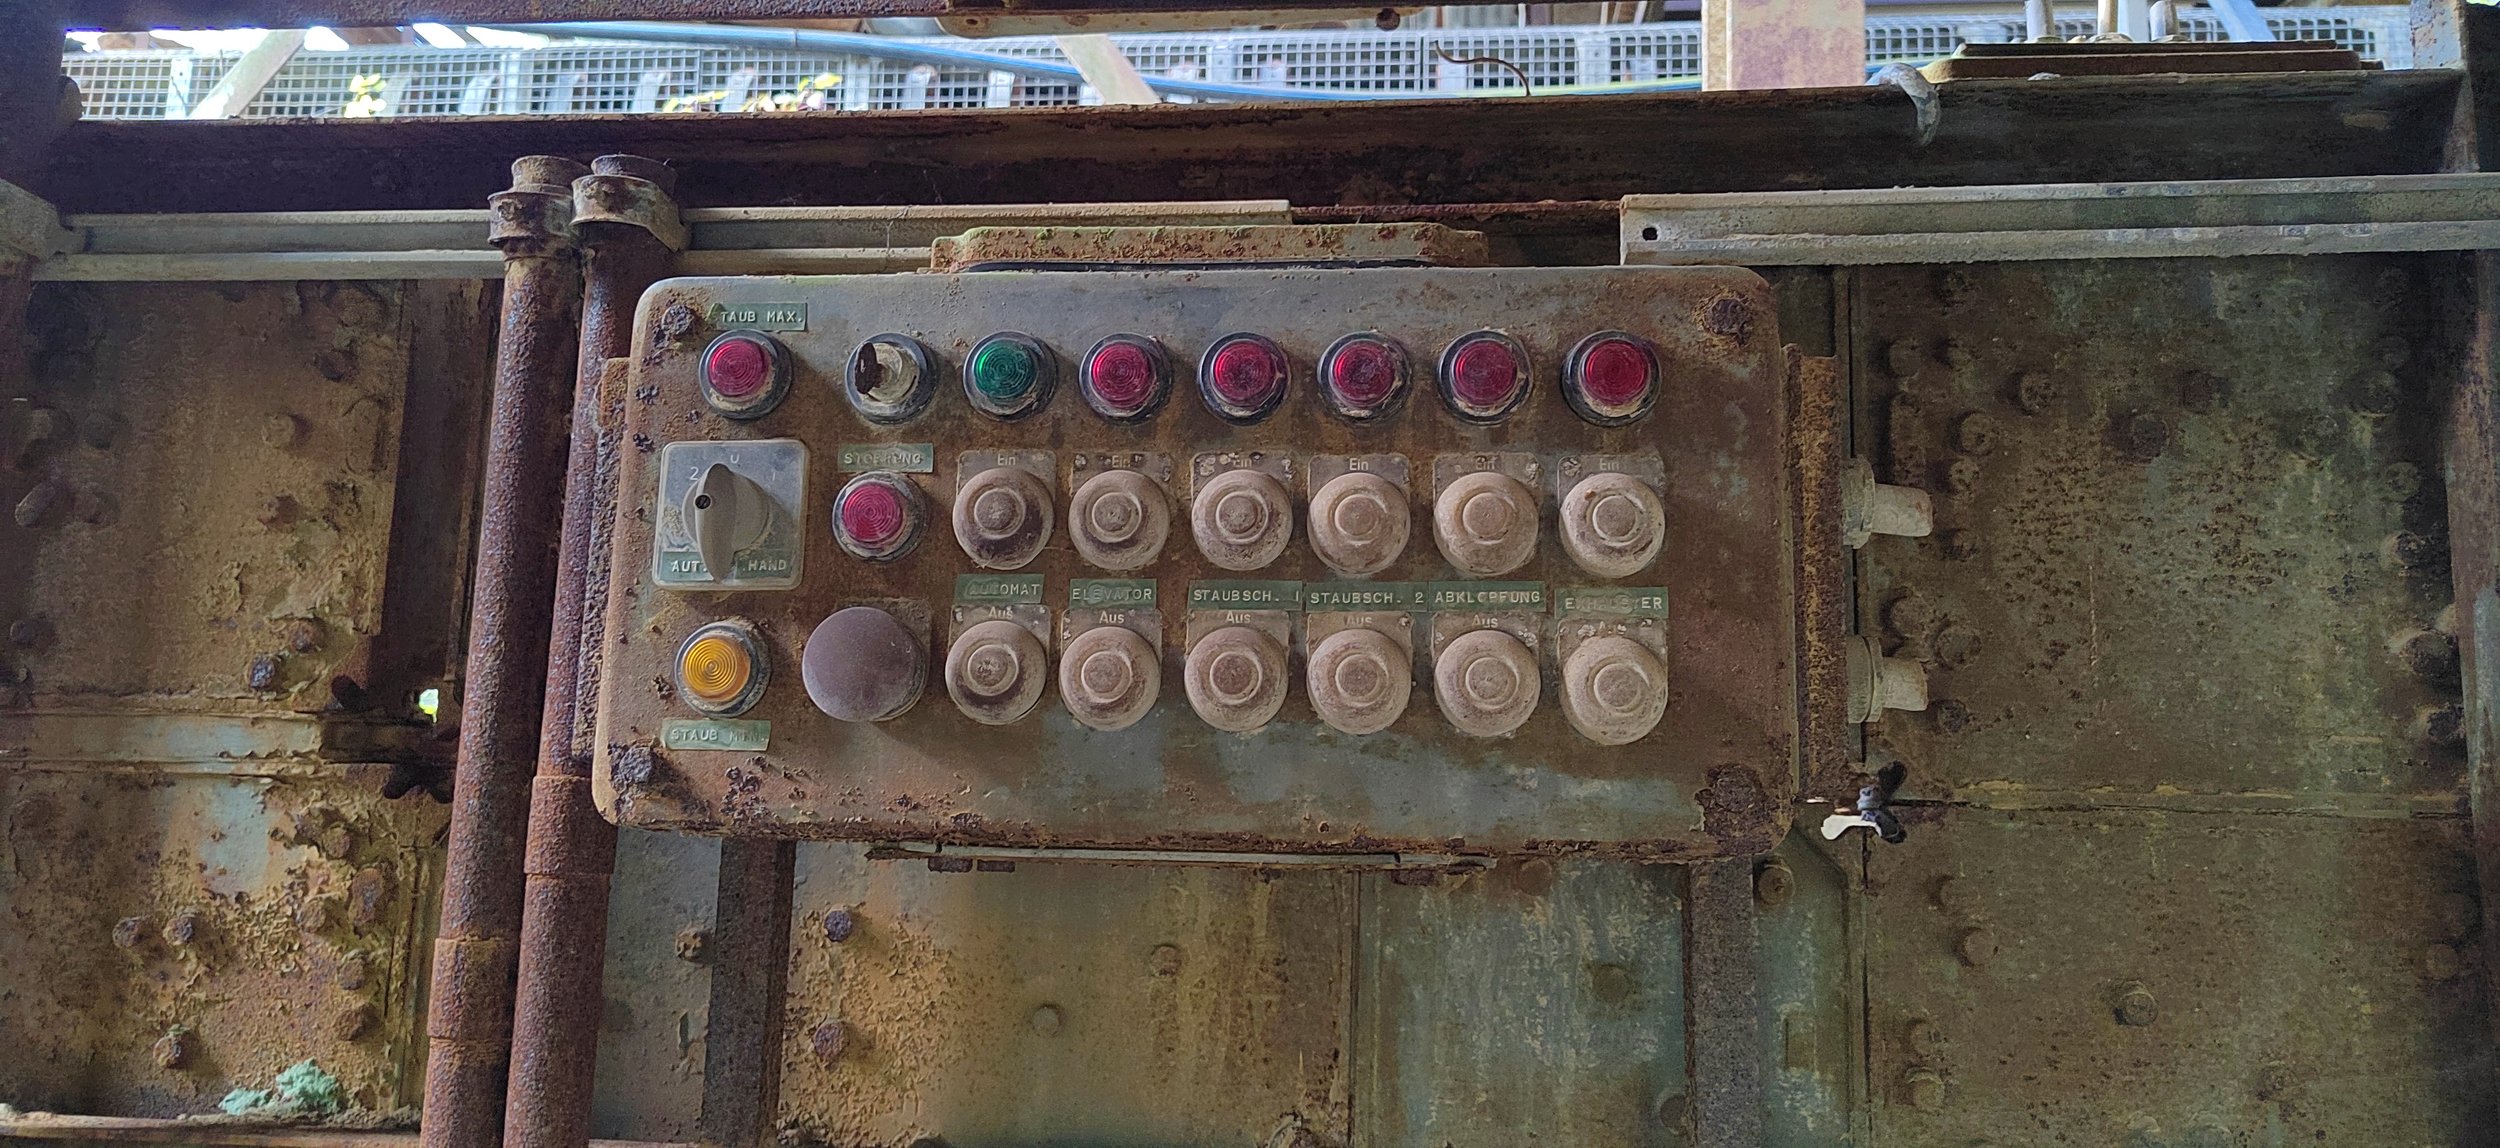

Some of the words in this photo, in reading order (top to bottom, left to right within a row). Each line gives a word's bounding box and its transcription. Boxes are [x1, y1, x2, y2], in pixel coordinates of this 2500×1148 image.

[767, 311, 803, 322] MAX.
[997, 455, 1016, 466] Ein
[1111, 455, 1131, 468] Ein
[1349, 457, 1369, 471] Ein
[1475, 459, 1496, 471] Ein
[1599, 459, 1620, 471] Ein
[689, 466, 699, 481] 2
[1072, 588, 1152, 601] ELEVATOR
[1193, 589, 1280, 602] STAUBSCH.
[1310, 592, 1402, 604] STAUBSCH.
[1415, 591, 1424, 603] 2
[1434, 590, 1541, 604] ABKLOPFUNG
[988, 606, 1014, 619] Aus
[1099, 610, 1125, 624] Aus
[1226, 610, 1251, 624] Aus
[1472, 614, 1499, 629] Aus
[670, 728, 719, 741] STAUB
